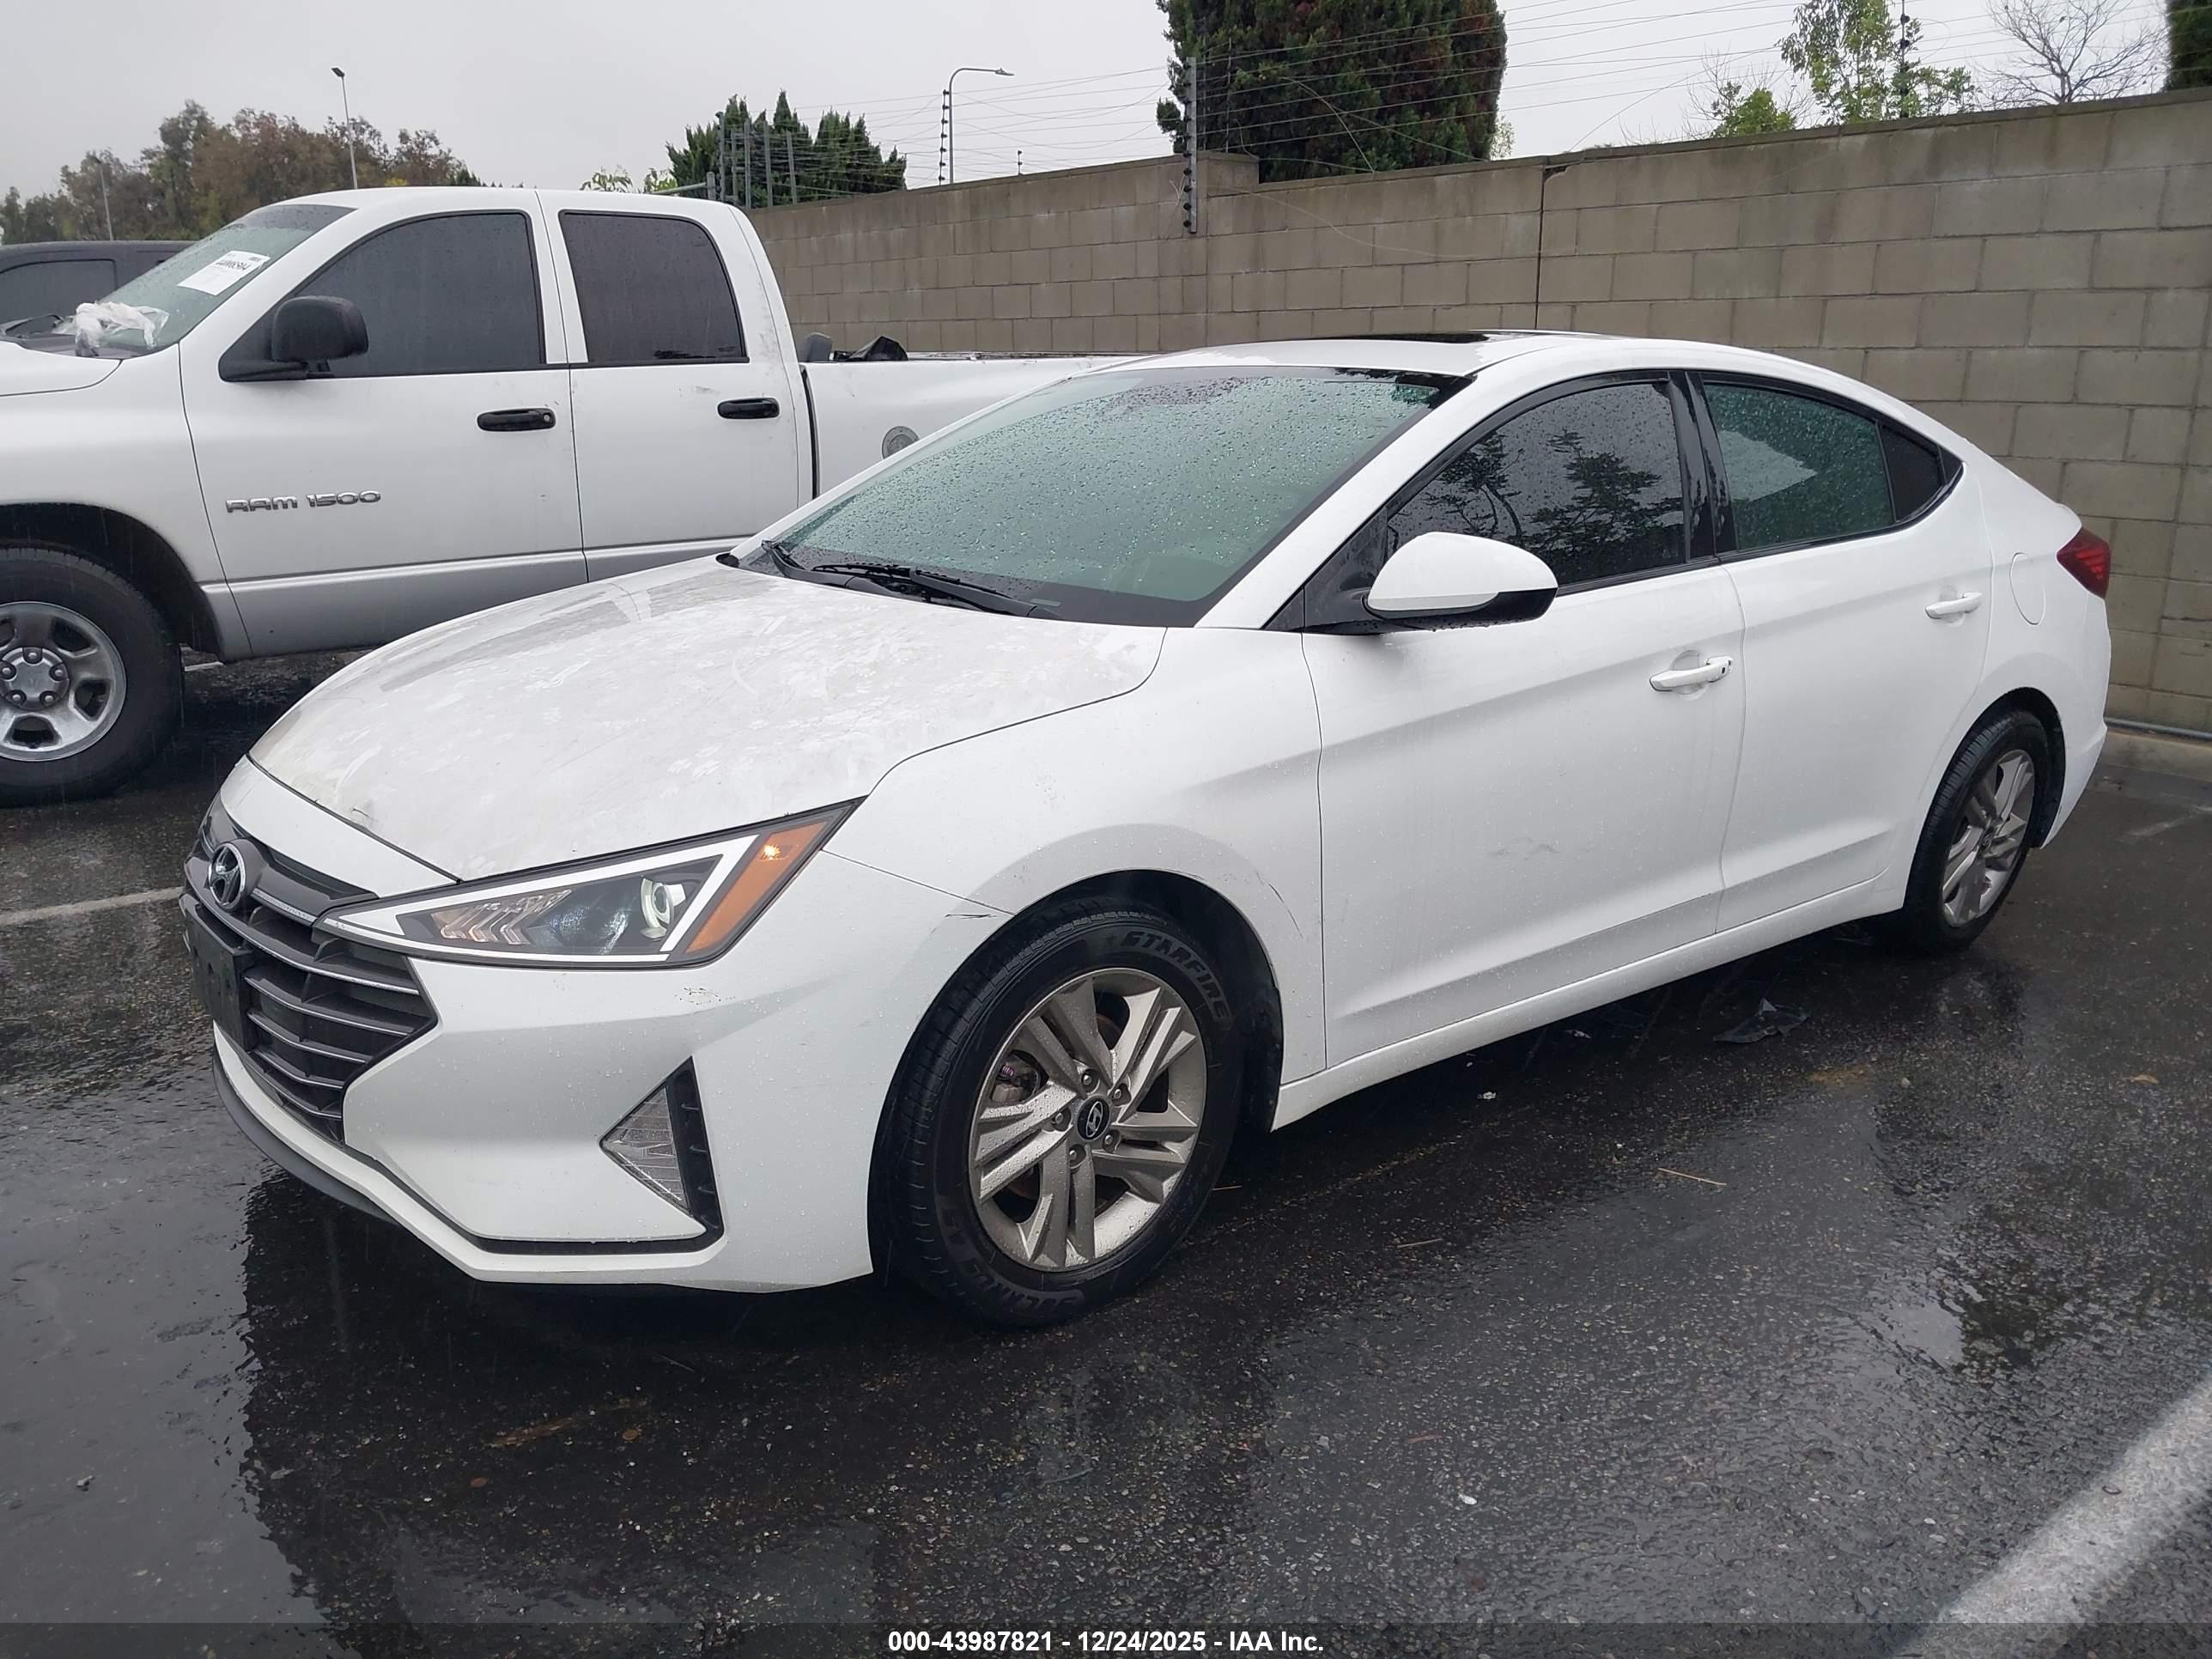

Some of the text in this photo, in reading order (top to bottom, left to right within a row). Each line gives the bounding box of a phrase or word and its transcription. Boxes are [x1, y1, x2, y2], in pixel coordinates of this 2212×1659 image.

[226, 490, 381, 514] RAM 1500
[1121, 931, 1230, 1018] STARFIRE
